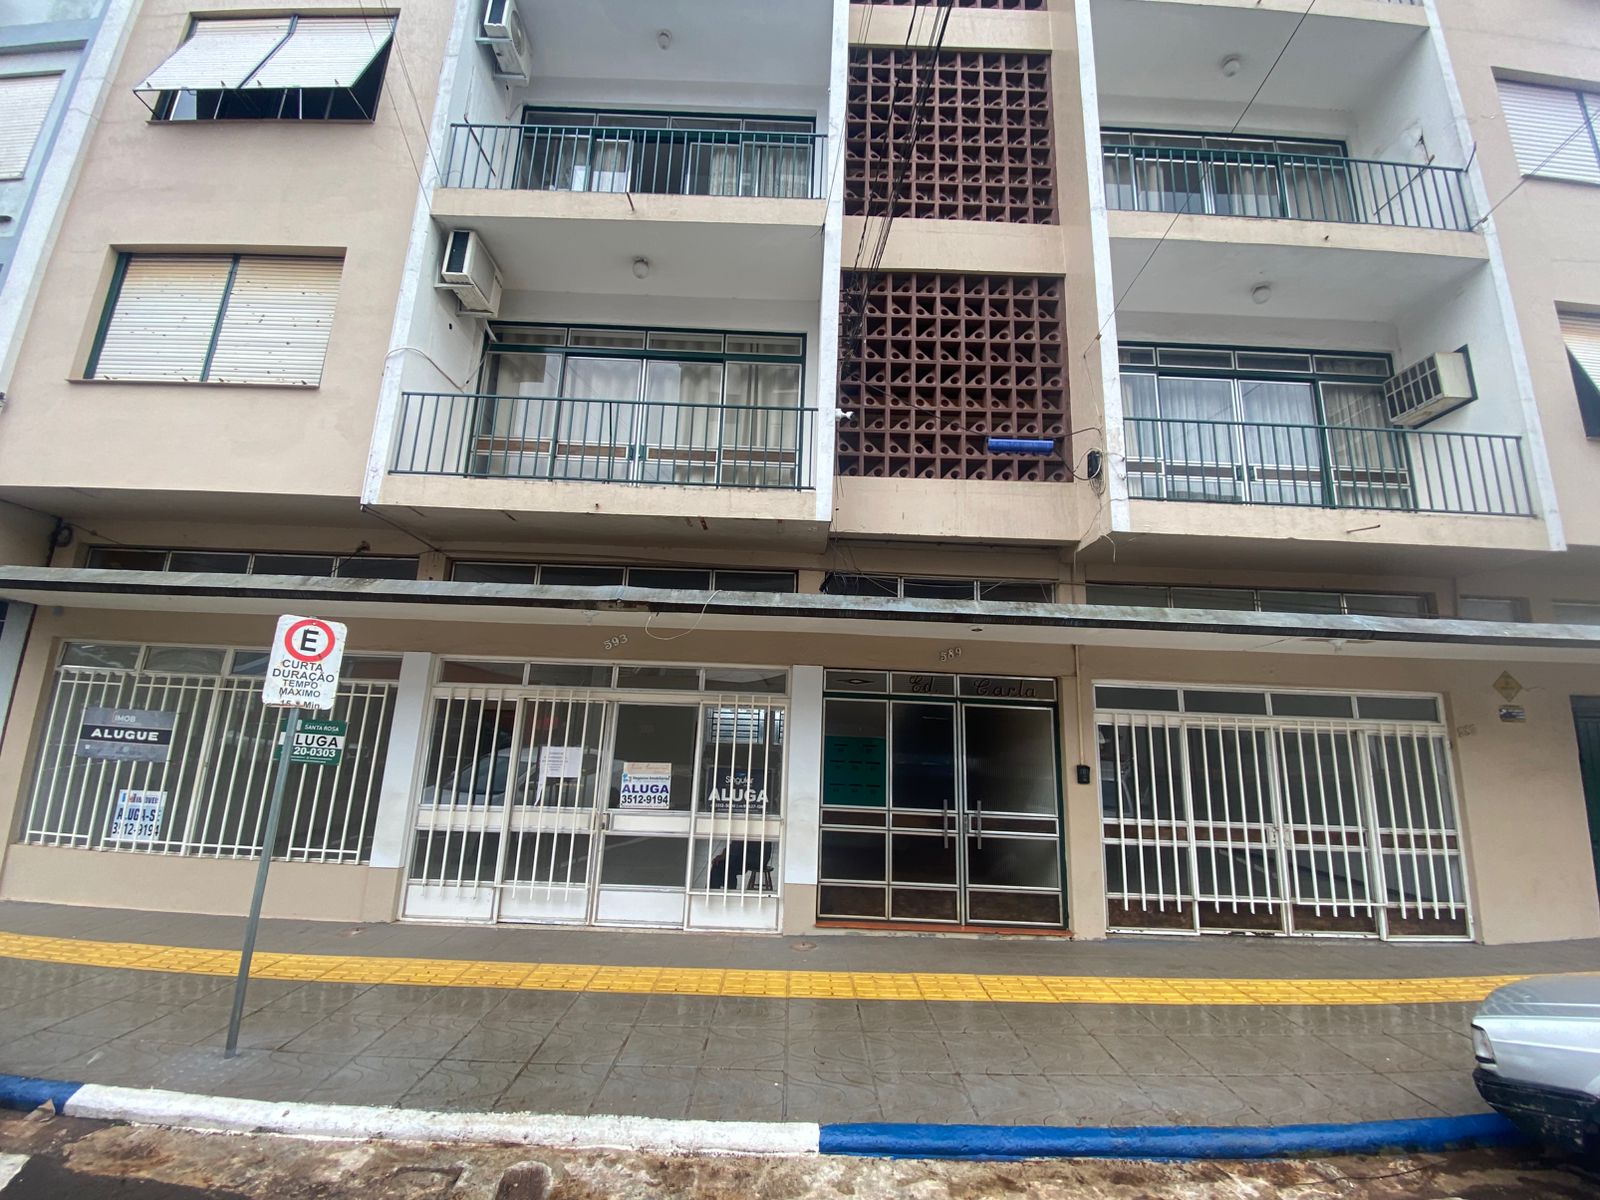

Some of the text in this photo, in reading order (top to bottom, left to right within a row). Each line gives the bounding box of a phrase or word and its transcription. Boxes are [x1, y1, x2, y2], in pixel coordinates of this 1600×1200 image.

[300, 628, 319, 652] E
[604, 634, 628, 650] 593
[940, 647, 962, 662] 589
[282, 659, 323, 672] CURTA
[272, 668, 335, 683] DURAÇÃO
[282, 678, 319, 690] TEMPO
[973, 678, 1037, 698] Carla
[115, 714, 136, 722] IMOB
[91, 728, 159, 741] ALUGUE
[294, 734, 338, 748] LUGA
[621, 784, 669, 794] ALUGA
[708, 787, 769, 802] ALUGA
[621, 794, 668, 804] 3512-9194
